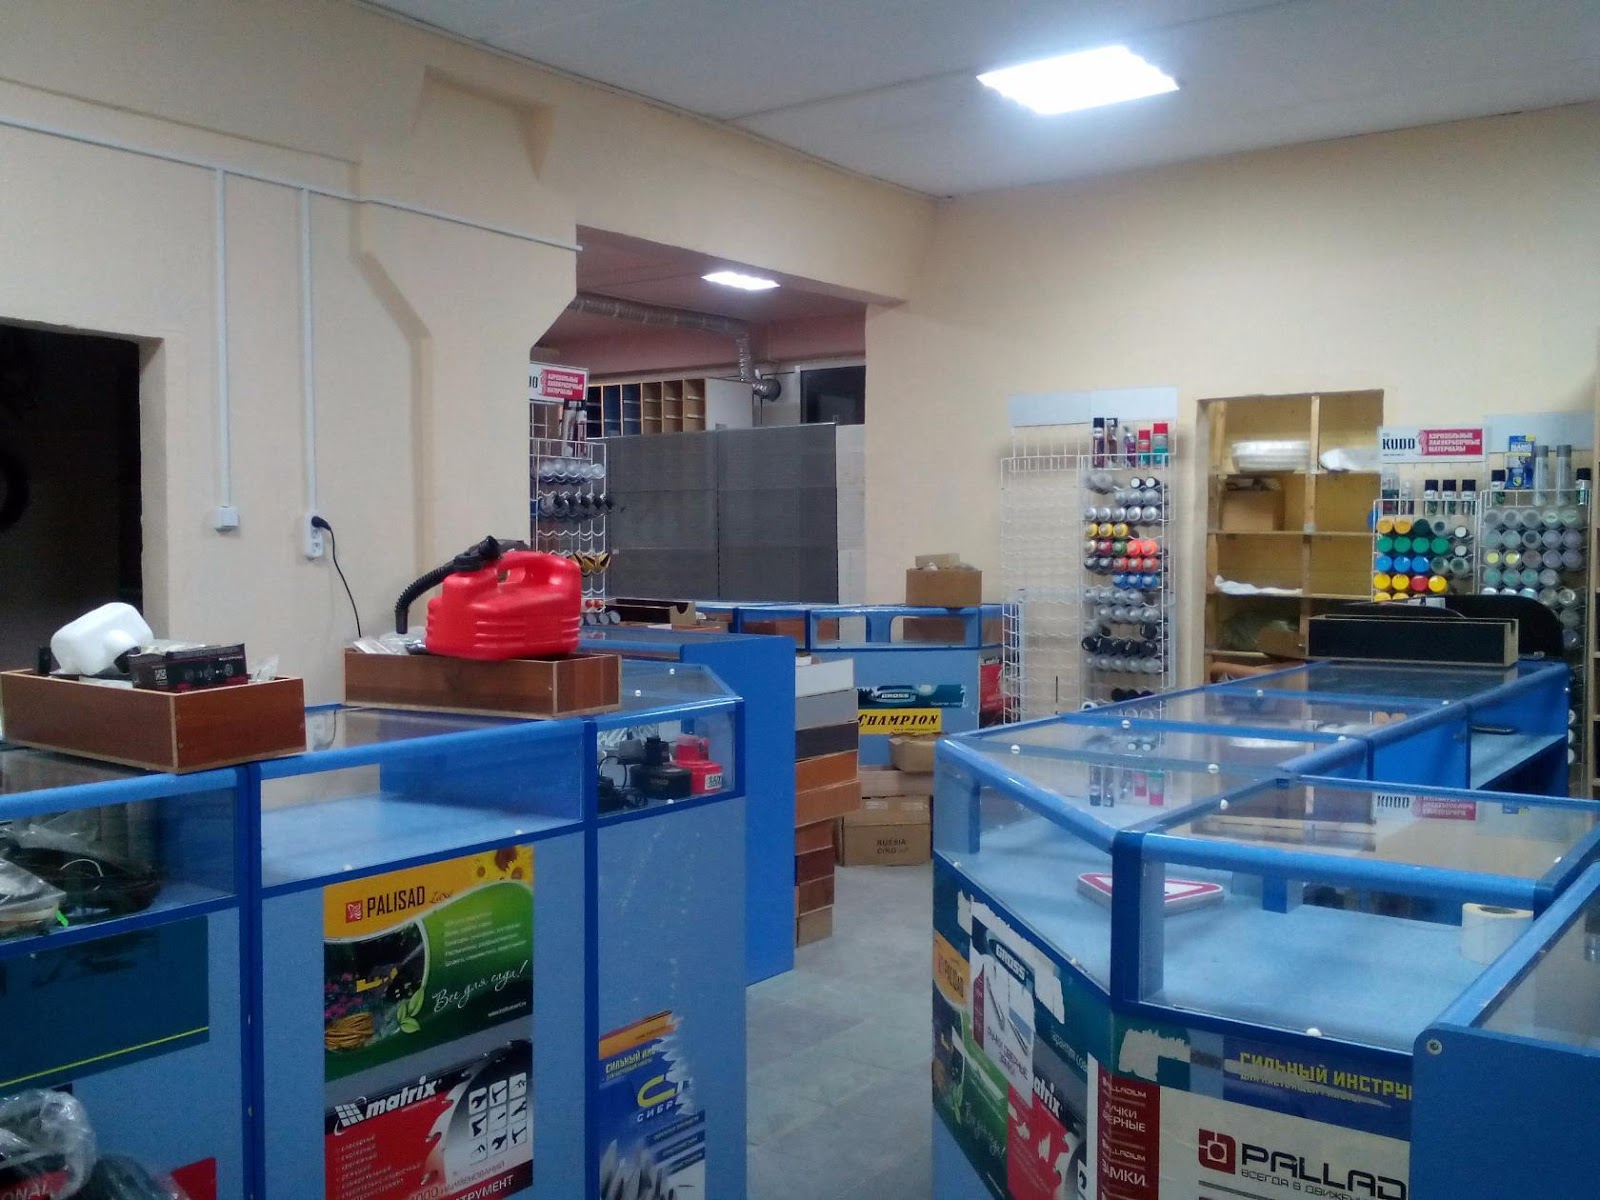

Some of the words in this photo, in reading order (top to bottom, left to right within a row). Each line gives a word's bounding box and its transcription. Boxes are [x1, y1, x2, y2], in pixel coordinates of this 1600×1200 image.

[1382, 438, 1415, 450] KUDO
[858, 714, 938, 727] CHAMPION
[367, 886, 425, 918] PALISAD
[996, 944, 1026, 981] GROSS
[366, 1075, 438, 1119] matrix
[637, 1099, 676, 1122] СИБР
[1033, 1076, 1062, 1118] atrix
[1241, 1143, 1408, 1200] PALLAD
[1241, 1168, 1289, 1188] ВСЕГДА
[1292, 1180, 1302, 1190] В
[453, 1174, 515, 1200] ТРУМЕНТ
